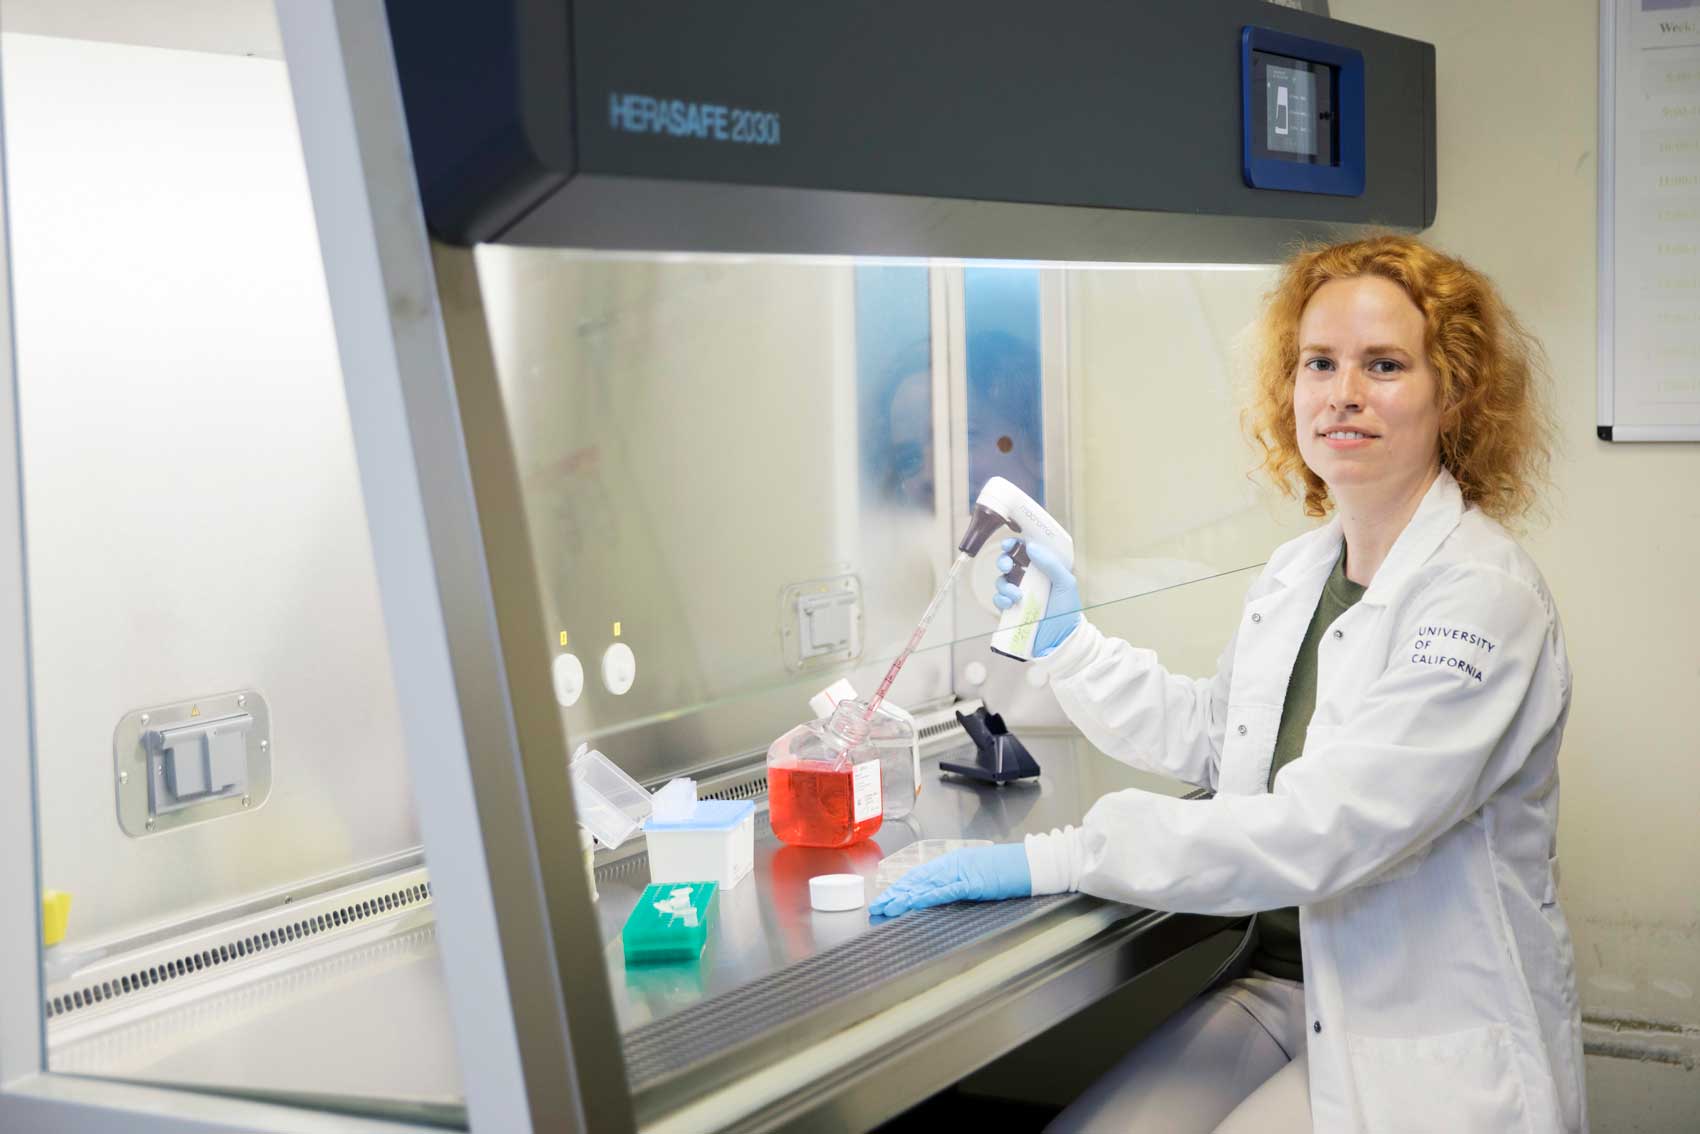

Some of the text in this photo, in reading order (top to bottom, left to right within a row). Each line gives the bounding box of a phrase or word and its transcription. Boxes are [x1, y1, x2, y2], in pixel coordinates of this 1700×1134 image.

[609, 92, 729, 140] HERASAFE
[1414, 640, 1432, 650] OF
[1418, 626, 1495, 653] UNIVERSITY
[1411, 653, 1483, 682] CALIFORNIA
